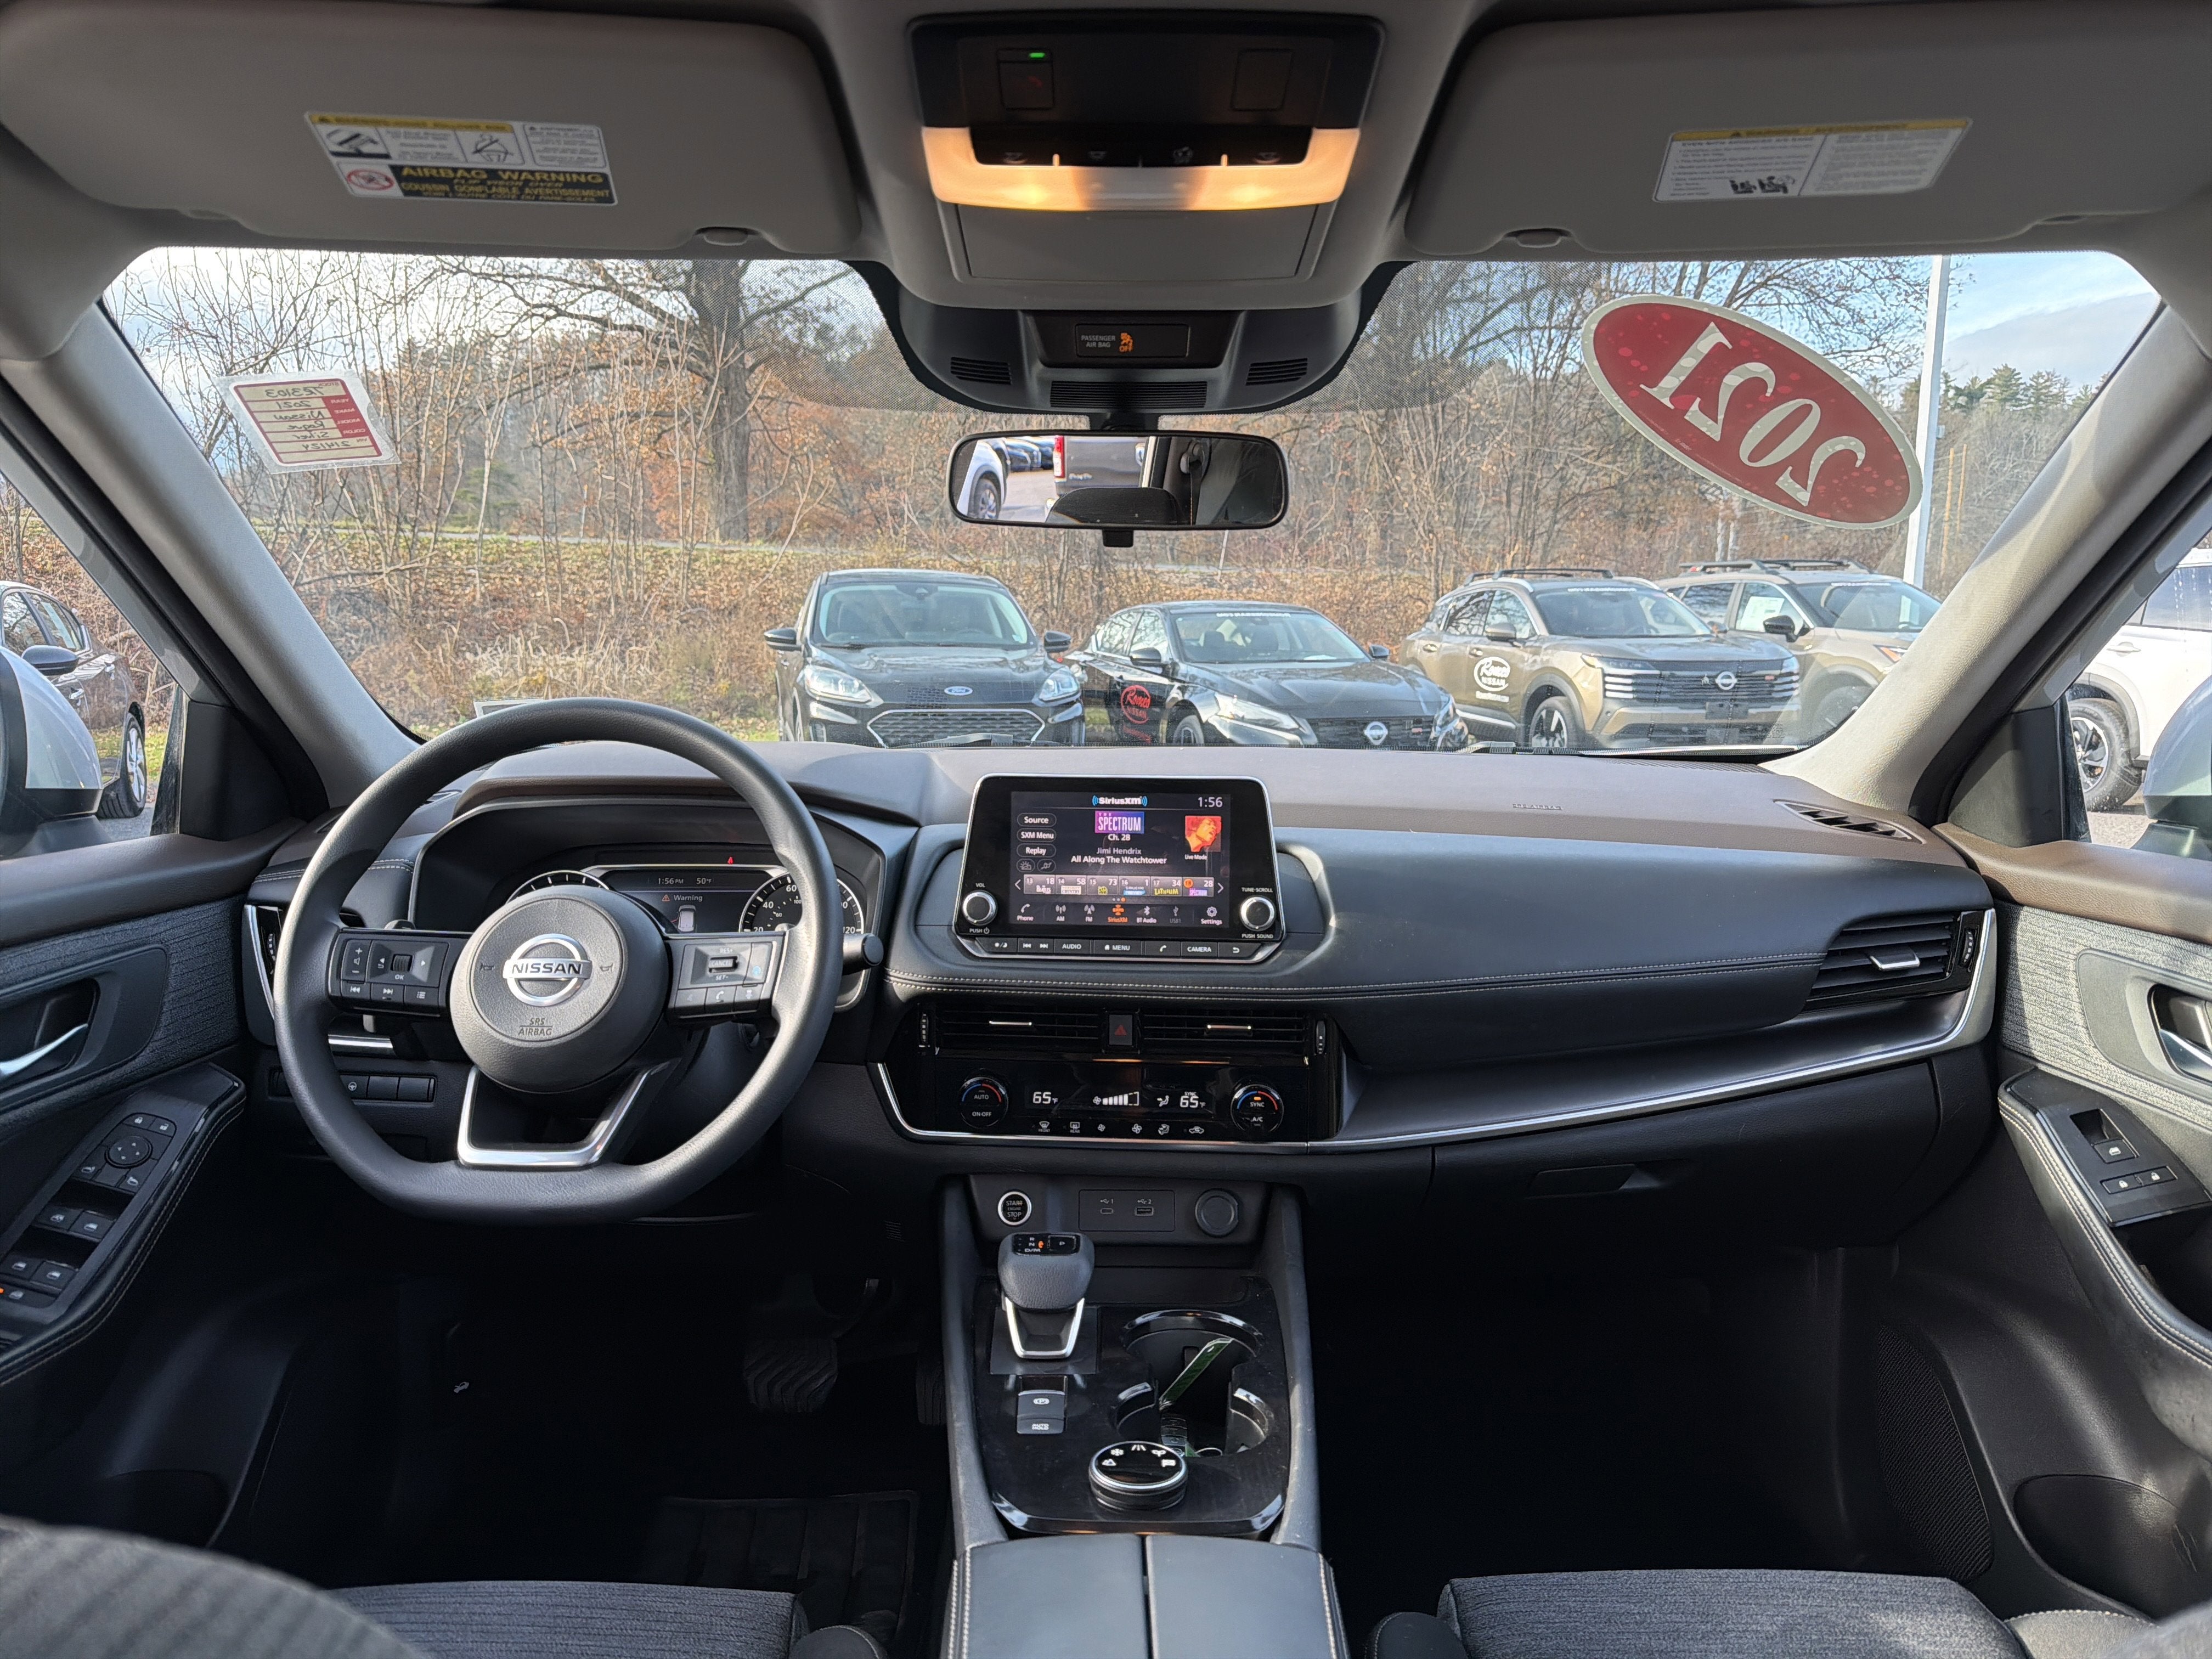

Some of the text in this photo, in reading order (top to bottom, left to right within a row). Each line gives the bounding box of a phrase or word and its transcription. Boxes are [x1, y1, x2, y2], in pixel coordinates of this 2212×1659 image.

[402, 167, 603, 183] AIRBAG WARNING
[1197, 797, 1223, 808] 1:56
[1098, 816, 1141, 831] SPECTRUM
[1025, 847, 1047, 855] Replay
[1083, 856, 1105, 865] Along
[512, 963, 582, 974] NISSAN
